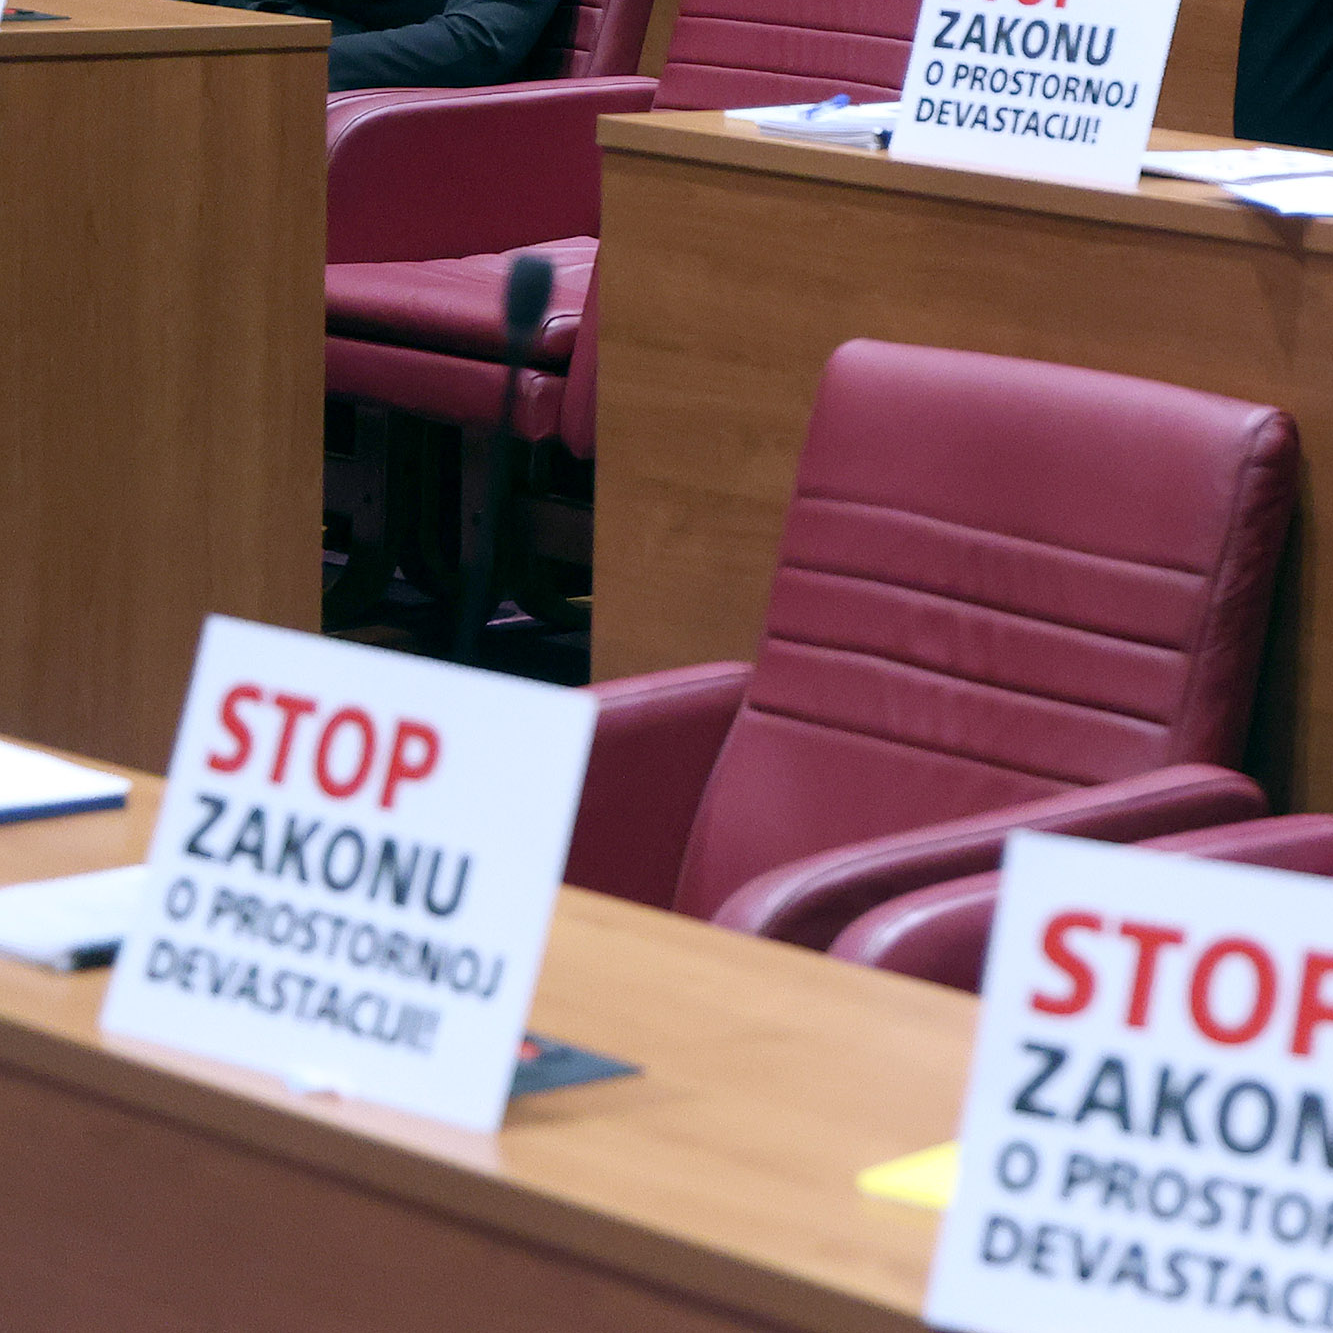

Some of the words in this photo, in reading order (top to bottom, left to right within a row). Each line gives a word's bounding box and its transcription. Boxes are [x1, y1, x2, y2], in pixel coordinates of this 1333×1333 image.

[933, 10, 1116, 66] ZAKONU
[925, 61, 944, 86] O
[952, 63, 1139, 109] PROSTORNOJ
[915, 97, 1101, 144] DEVASTACIJI!
[206, 683, 443, 810] STOP
[186, 794, 472, 918] ZAKONU
[164, 877, 197, 922] O
[994, 1140, 1039, 1192] O
